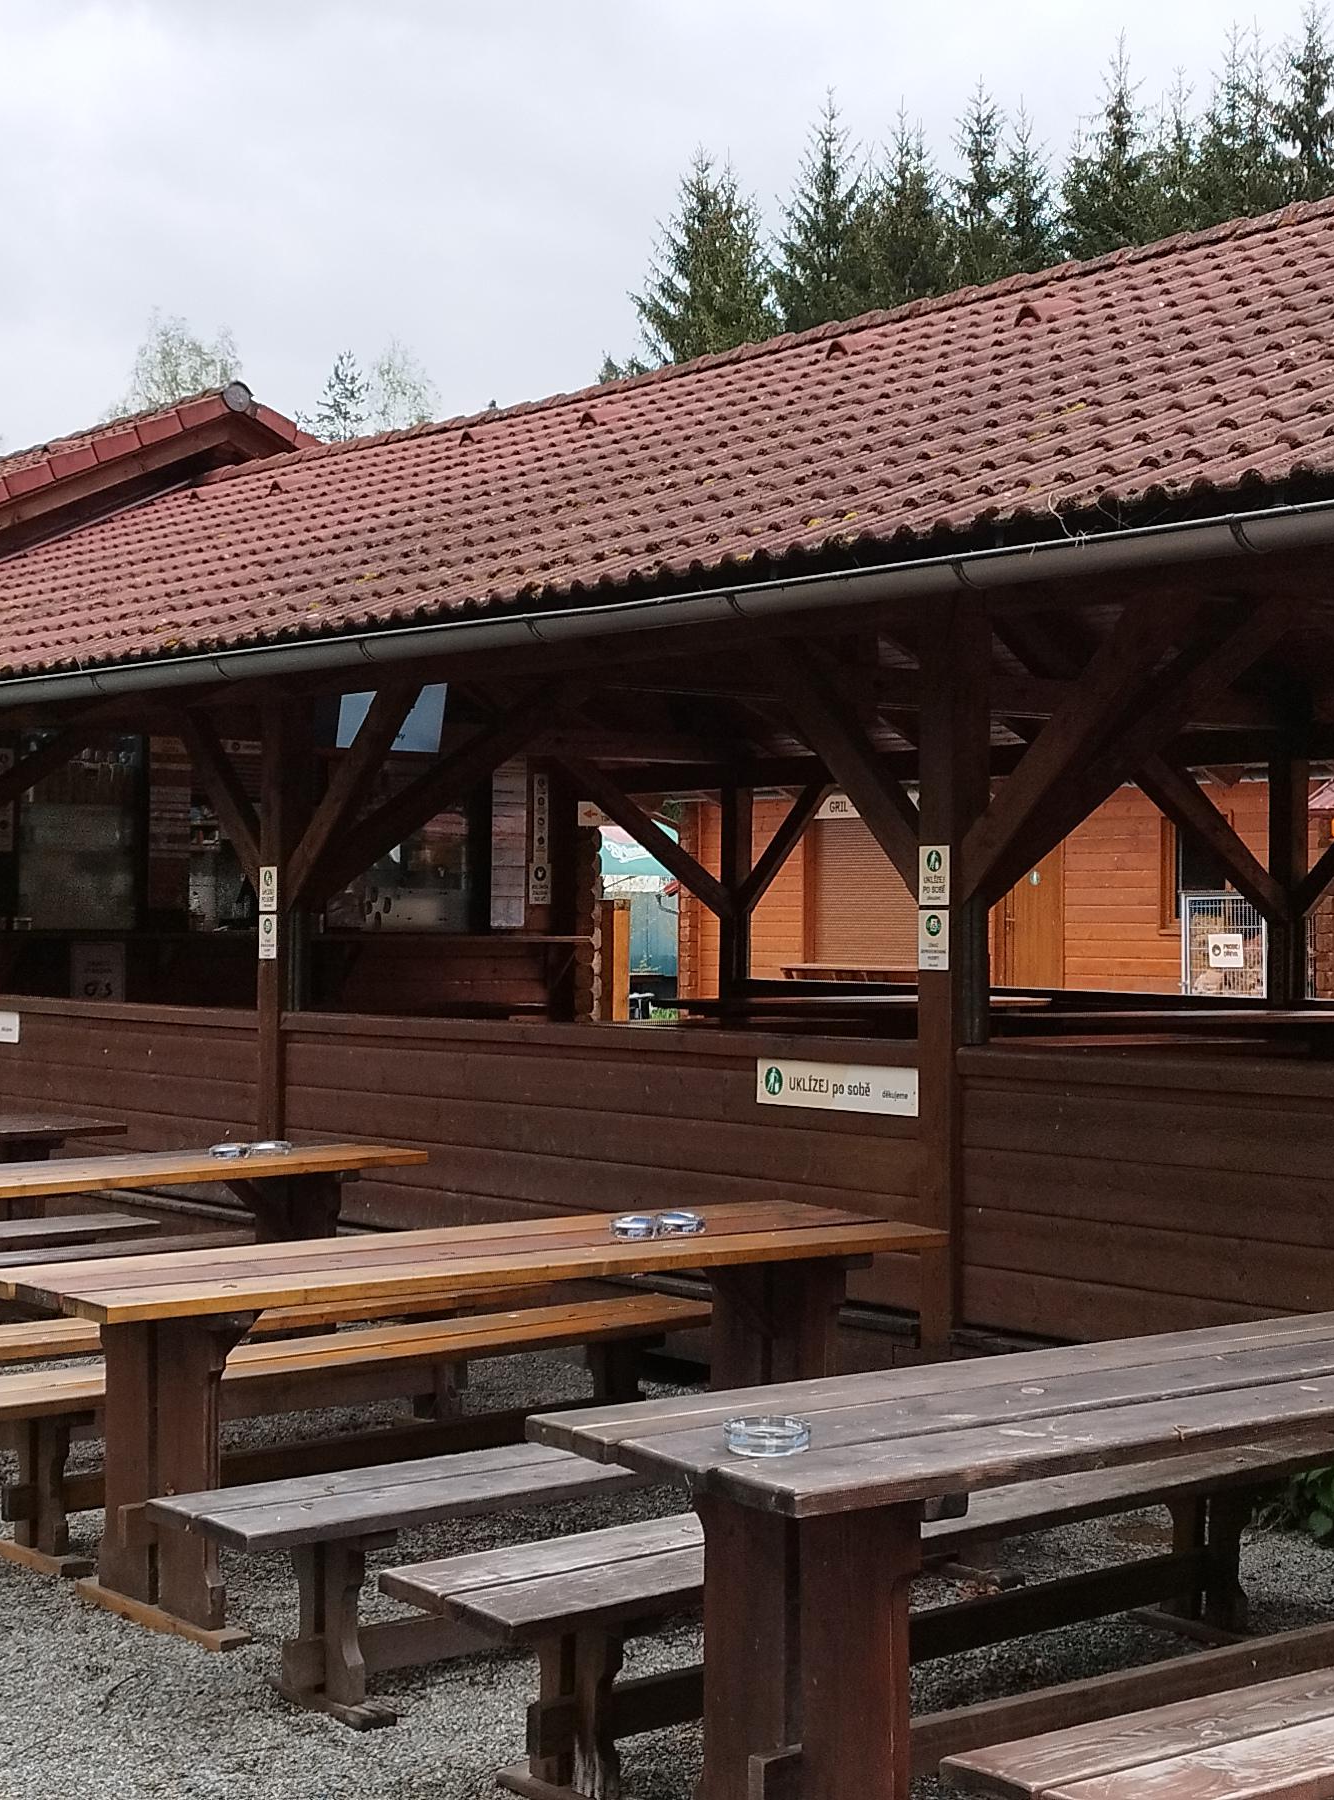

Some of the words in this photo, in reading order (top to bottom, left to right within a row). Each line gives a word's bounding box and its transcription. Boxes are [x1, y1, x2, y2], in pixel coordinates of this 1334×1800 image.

[829, 801, 848, 812] GRIL
[789, 1075, 829, 1093] UKLÍZEJ
[832, 1083, 845, 1098] po
[847, 1082, 871, 1097] sobě
[882, 1090, 908, 1101] děkujeme
